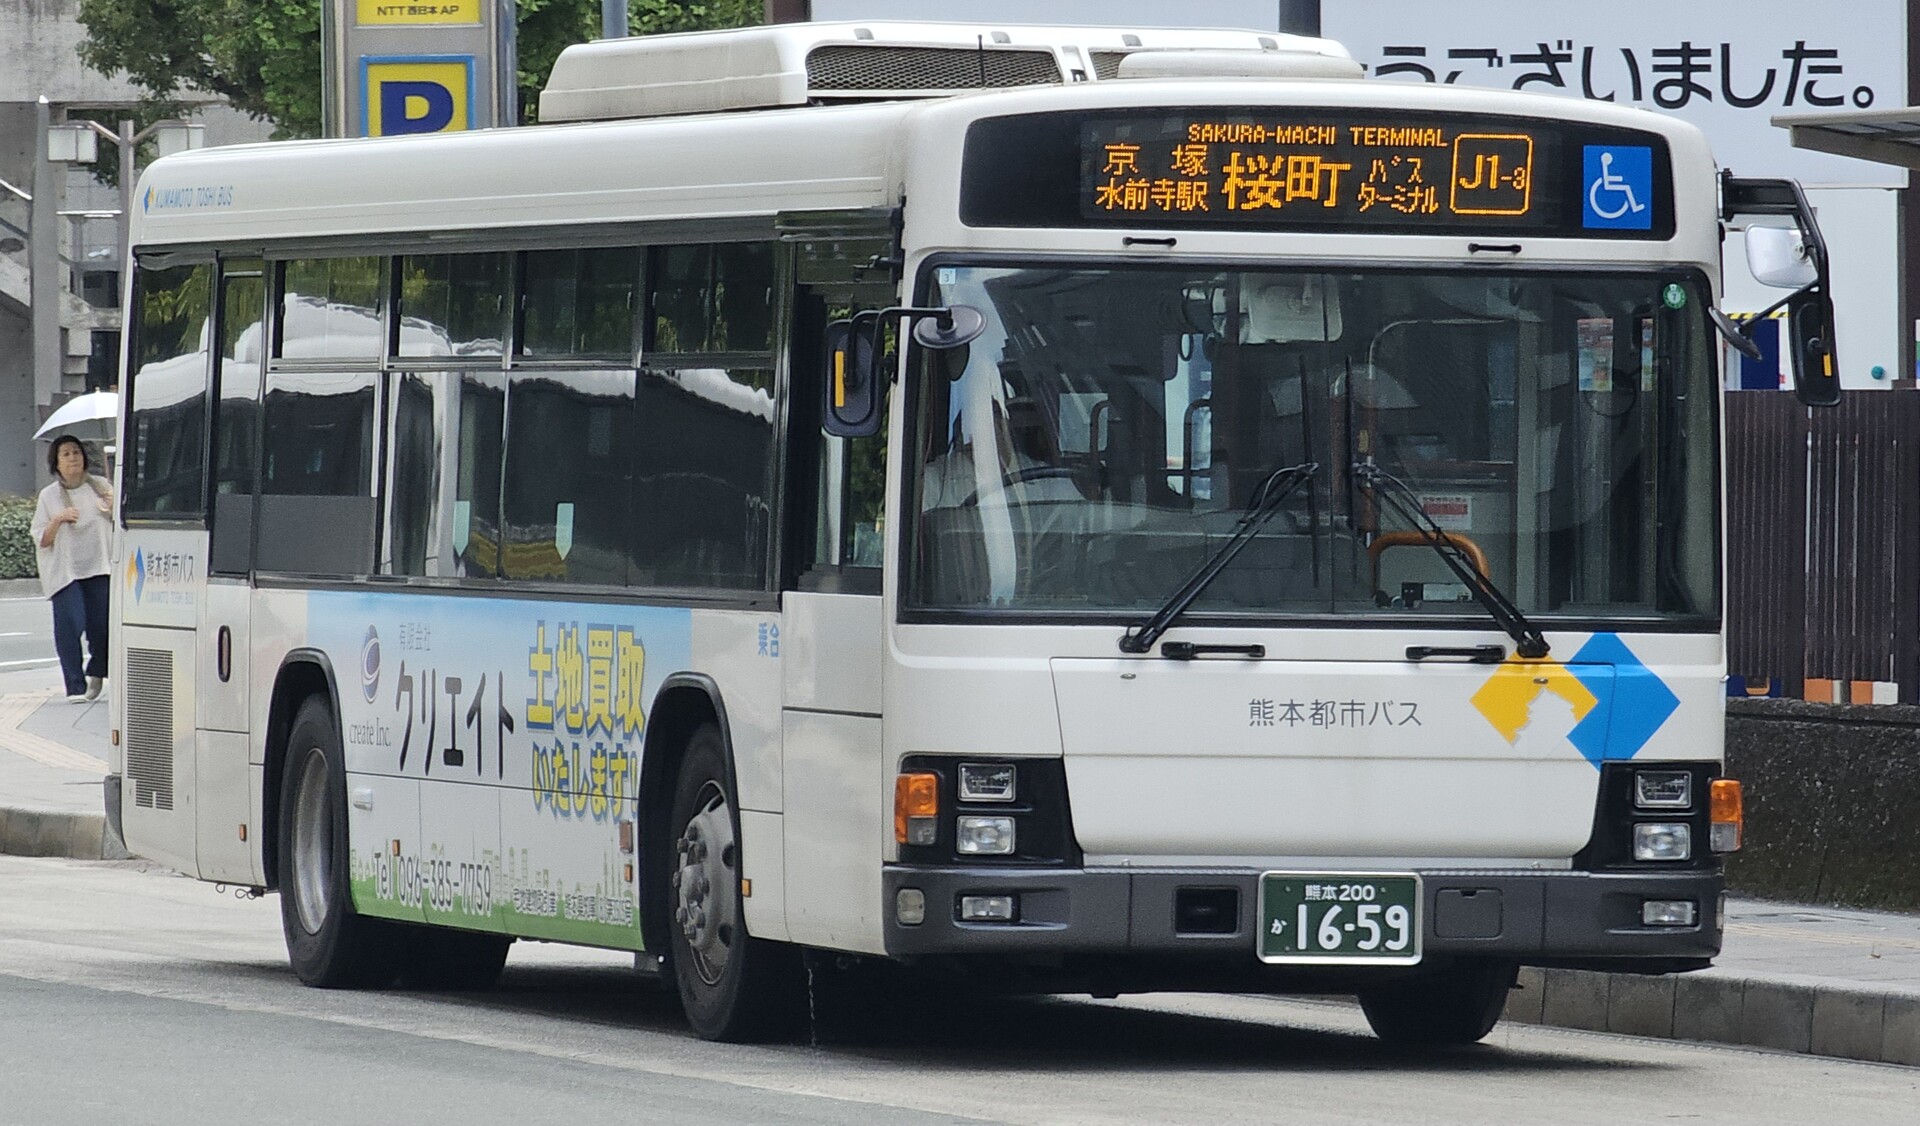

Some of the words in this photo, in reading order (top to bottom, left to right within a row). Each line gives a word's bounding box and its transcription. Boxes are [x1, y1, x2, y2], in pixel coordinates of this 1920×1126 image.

[381, 81, 454, 136] P
[1188, 123, 1336, 145] SAKURA-MACHI
[1350, 126, 1448, 147] TERMINAL
[1221, 152, 1351, 210] 桜町
[1368, 154, 1424, 183] バス
[1459, 154, 1527, 190] J1-3
[218, 185, 233, 206] BUS
[1095, 177, 1209, 211] 水前寺駅
[1357, 182, 1439, 214] ターミナル
[147, 551, 194, 585] 熊本都市バス
[400, 622, 431, 651] 有限会社
[758, 622, 779, 657] 乗合
[526, 620, 645, 742] 土地買取
[396, 659, 514, 780] クリエイト
[1248, 698, 1422, 730] 熊本都市バス
[350, 720, 374, 745] create
[376, 717, 391, 747] Inc.
[374, 852, 392, 897] Tel
[399, 855, 492, 914] 096-385-7759
[1271, 918, 1288, 935] か
[1297, 904, 1409, 950] 16-59
